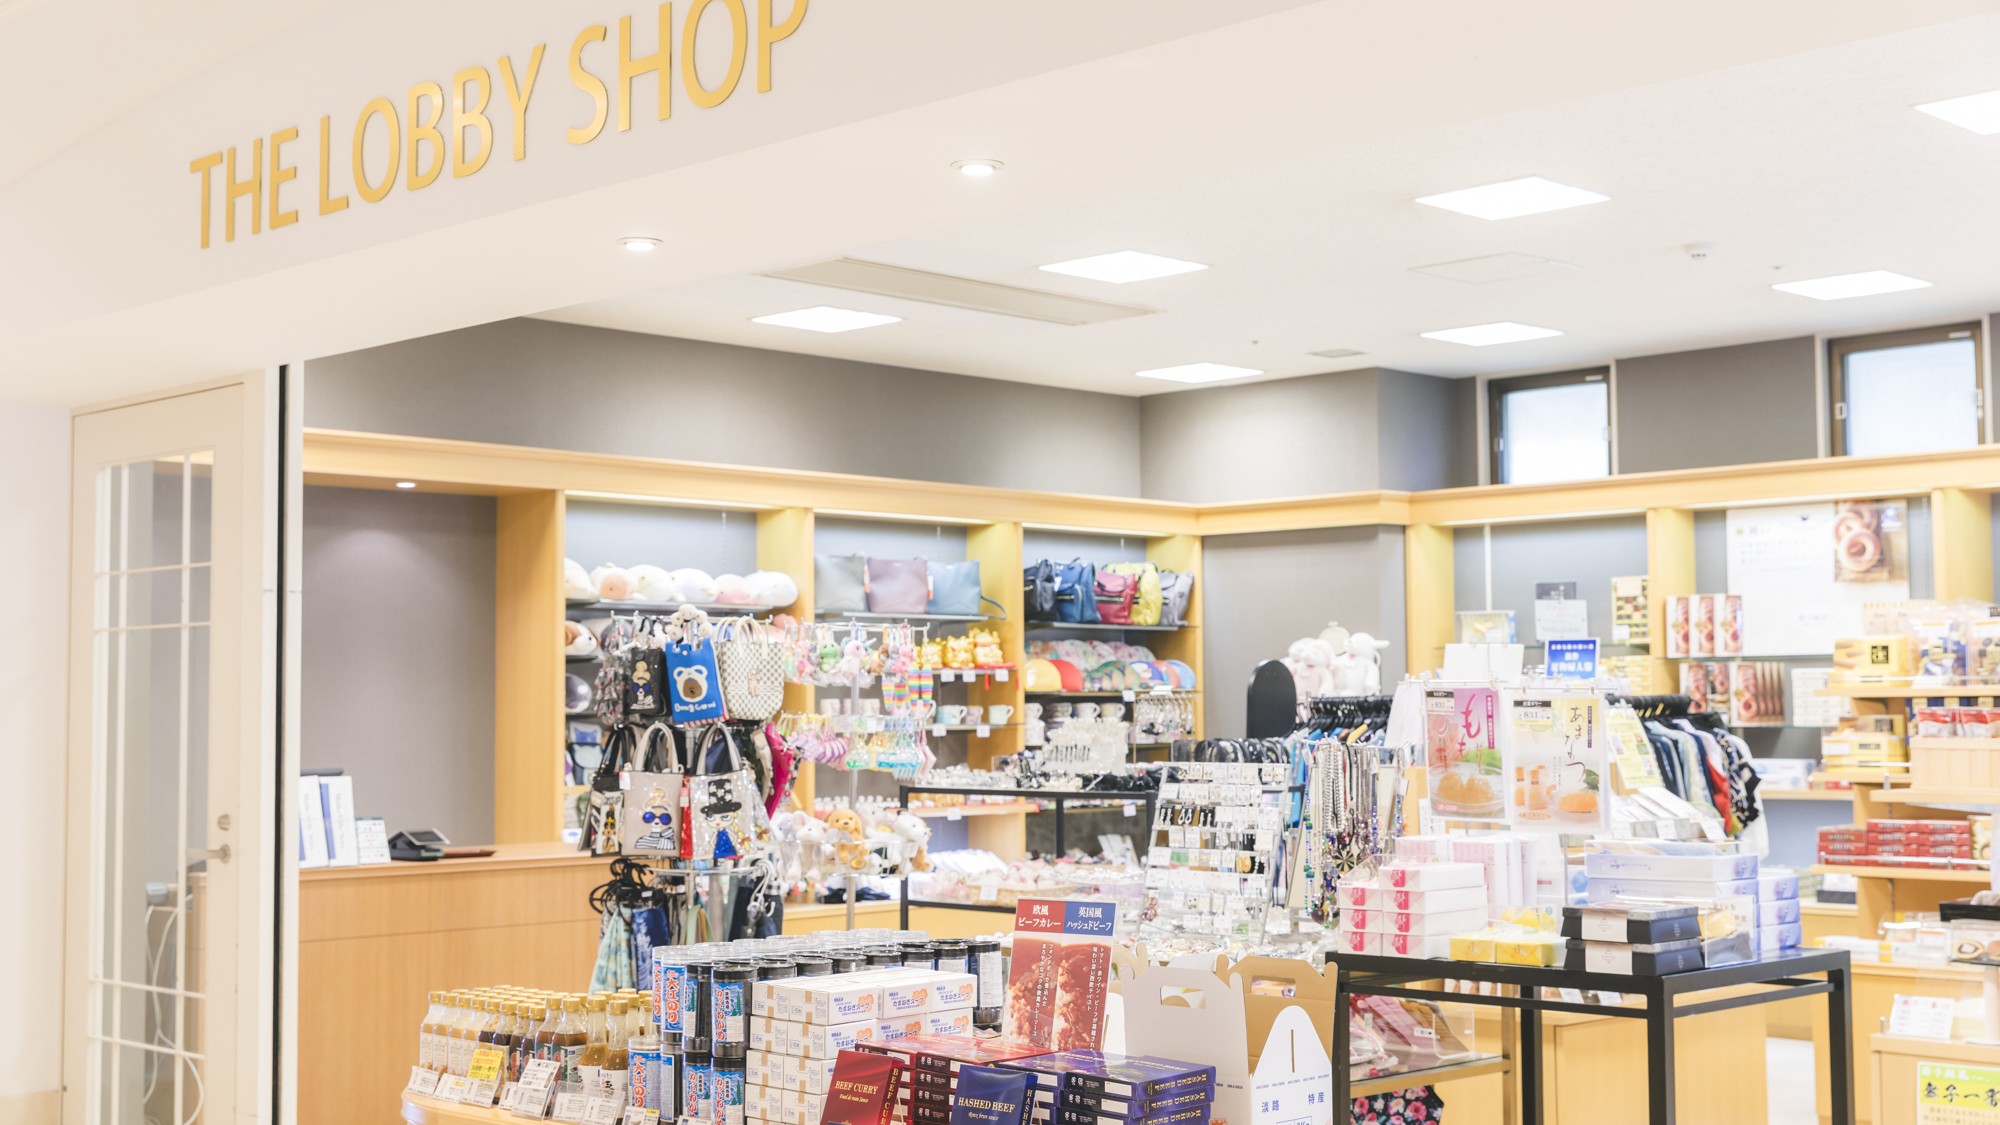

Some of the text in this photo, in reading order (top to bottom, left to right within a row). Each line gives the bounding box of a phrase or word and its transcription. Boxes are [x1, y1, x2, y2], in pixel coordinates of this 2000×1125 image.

[189, 0, 809, 250] THE LOBBY SHOP
[1523, 711, 1539, 720] 831
[1032, 904, 1049, 917] 欧風
[1077, 906, 1103, 919] 英国風
[1017, 916, 1062, 929] ビーフカレー
[1066, 920, 1112, 932] ハッシュドビーフ
[666, 978, 680, 1024] 大江のり
[892, 996, 924, 1008] たまねぎスープ
[940, 991, 970, 1001] たまねぎスープ
[838, 1002, 870, 1013] たまねぎスープ
[715, 988, 726, 1041] カットわかめ
[935, 1023, 967, 1033] たまねぎスープ
[885, 1030, 918, 1040] たまねぎスープ
[836, 1036, 868, 1048] たまねぎスープ
[633, 1063, 646, 1107] 大江のり
[887, 1067, 899, 1099] BEEF
[1154, 1081, 1176, 1091] BEEF
[1176, 1073, 1208, 1087] HASHED
[834, 1080, 879, 1095] BEEF CURRY
[958, 1096, 1016, 1113] HASHED BEEF
[1151, 1091, 1206, 1109] HASHED BEEF
[1170, 1109, 1202, 1122] HASHED
